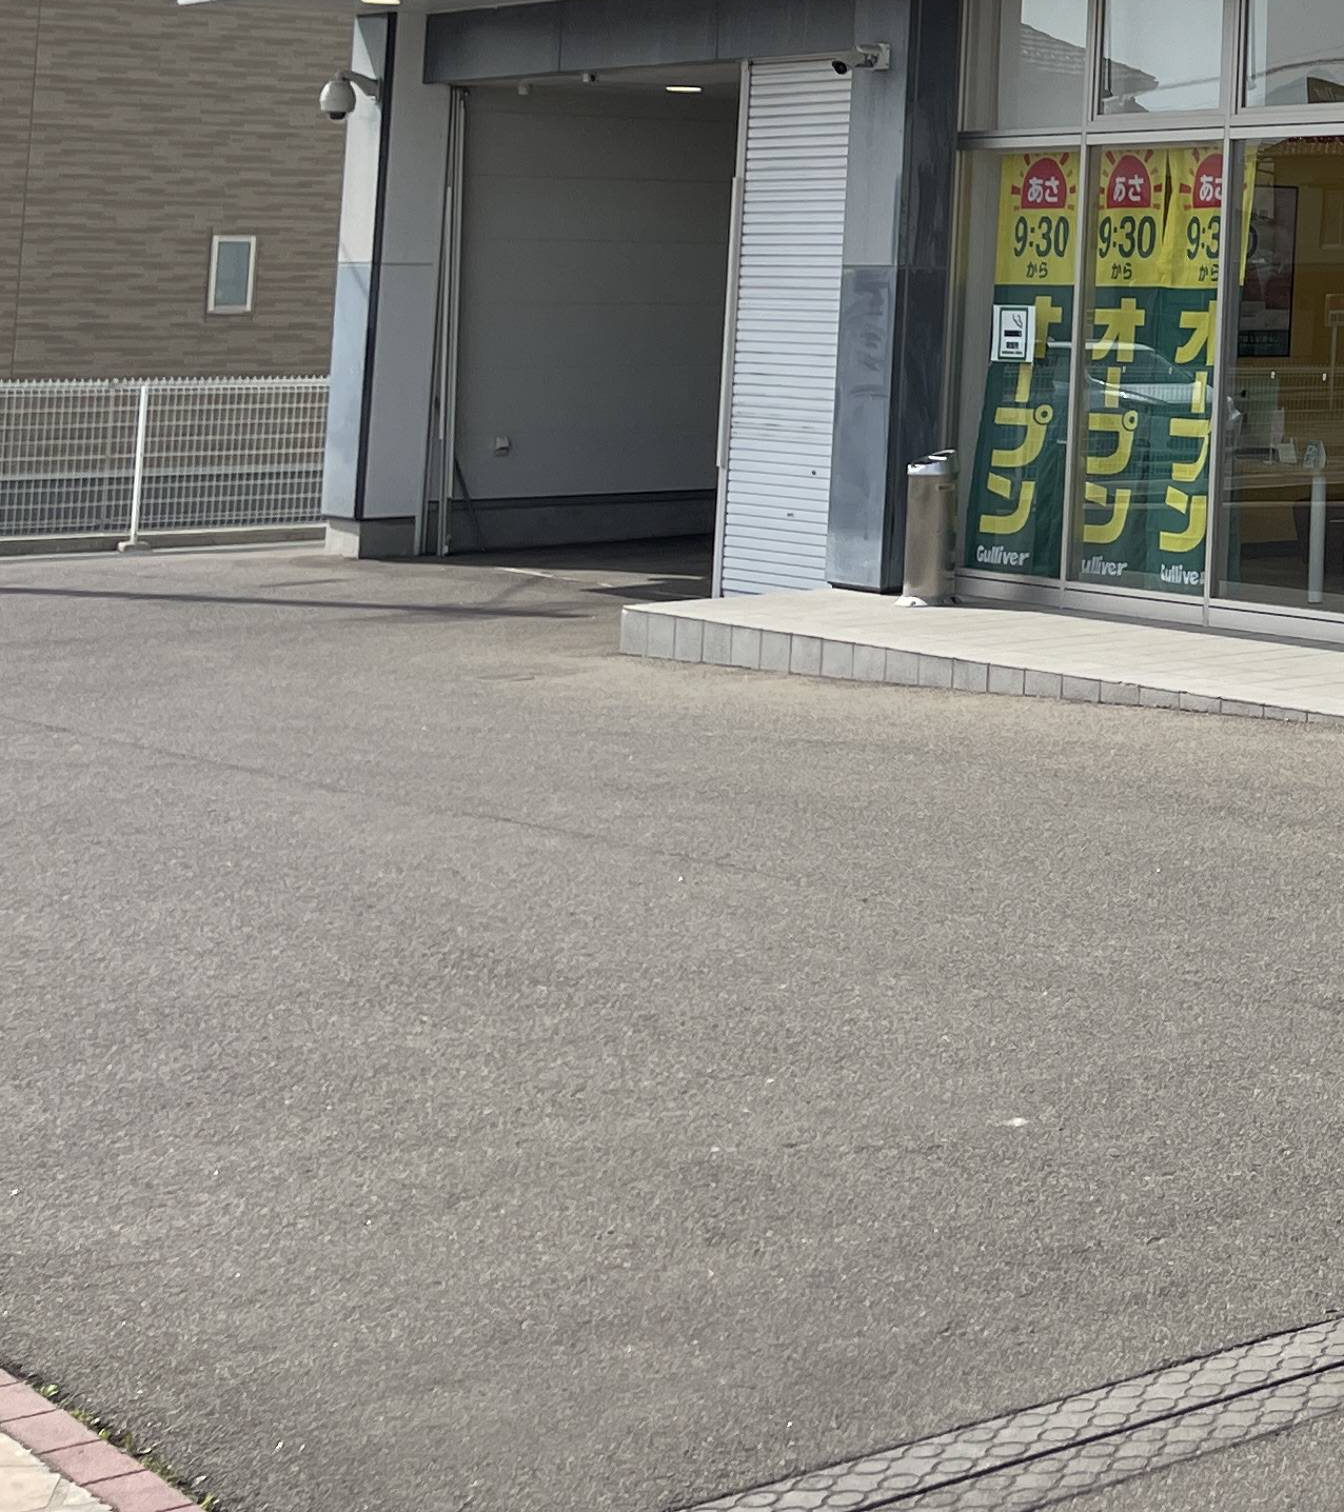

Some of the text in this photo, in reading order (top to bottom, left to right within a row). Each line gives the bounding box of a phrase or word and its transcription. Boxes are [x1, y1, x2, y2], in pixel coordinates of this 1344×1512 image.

[1027, 176, 1060, 203] あさ
[1013, 216, 1070, 257] 9:30
[1098, 215, 1157, 258] 9:30
[1186, 216, 1220, 260] 9:3
[1026, 261, 1049, 279] から
[1110, 263, 1133, 280] から
[1083, 298, 1146, 544] オープン
[976, 544, 1030, 567] Gulliver
[1081, 555, 1128, 576] ulliver
